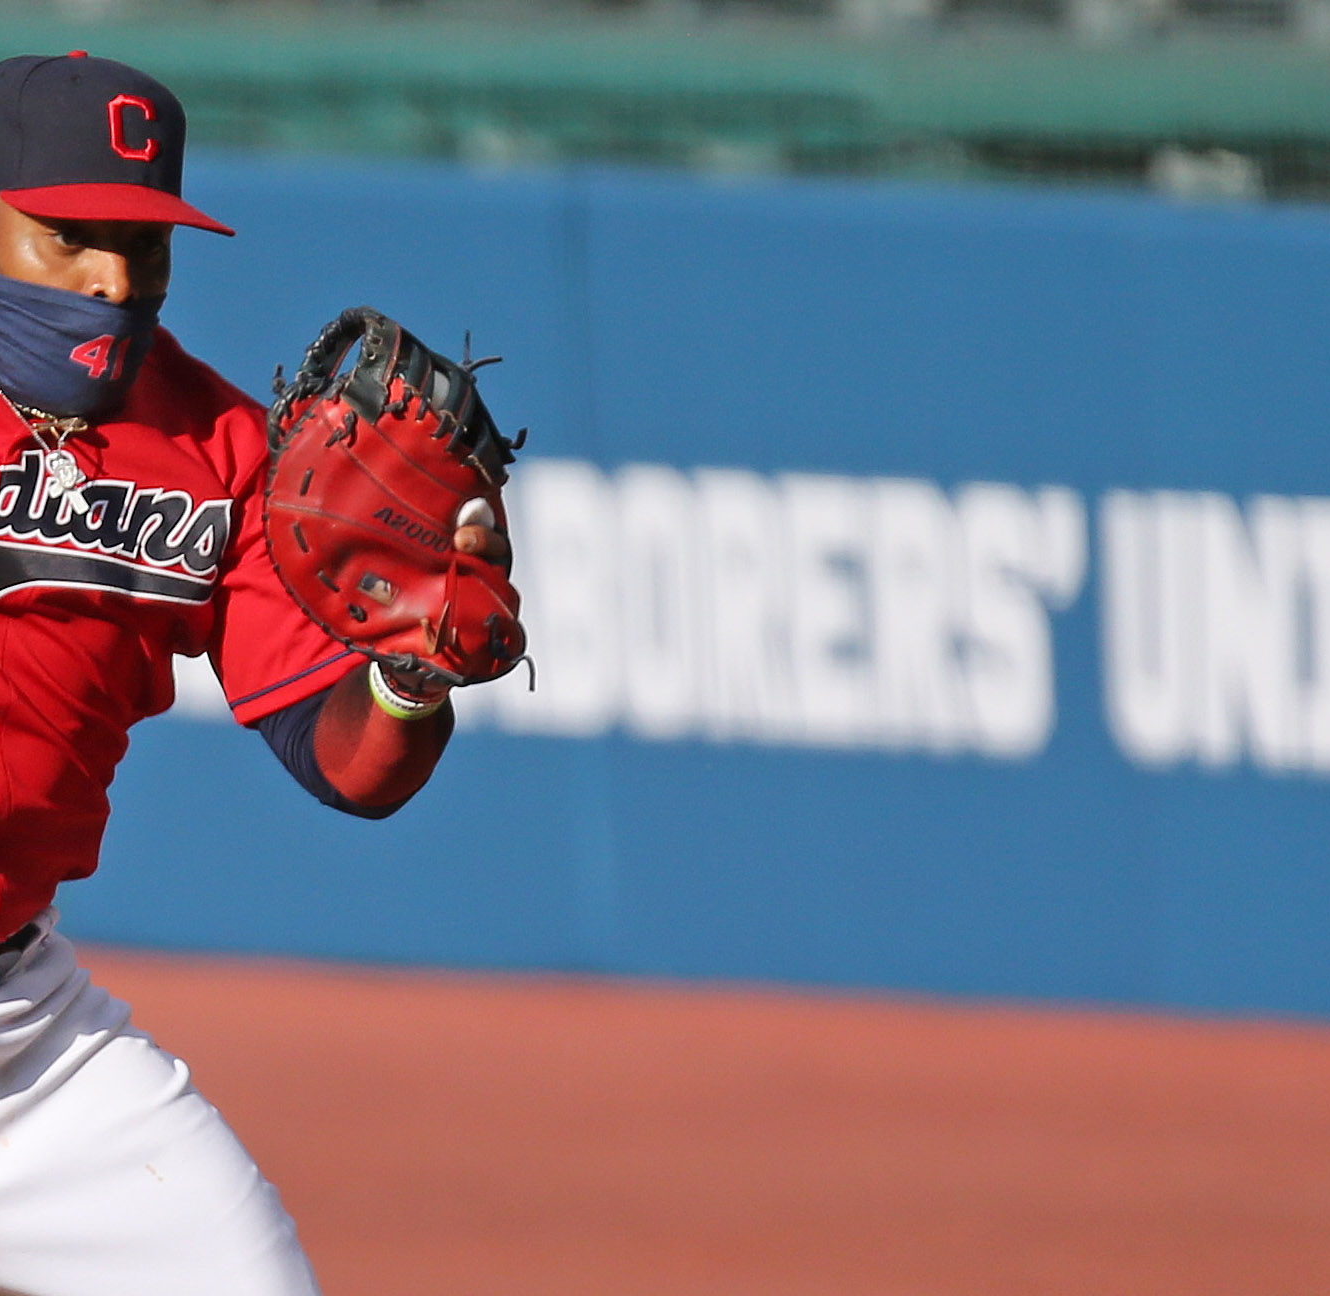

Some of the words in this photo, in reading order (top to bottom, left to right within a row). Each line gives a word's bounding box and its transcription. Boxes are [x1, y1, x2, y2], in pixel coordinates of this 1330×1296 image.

[108, 93, 160, 162] C
[69, 333, 132, 379] 41
[373, 506, 450, 553] A2000
[456, 458, 1091, 763] BORERS'
